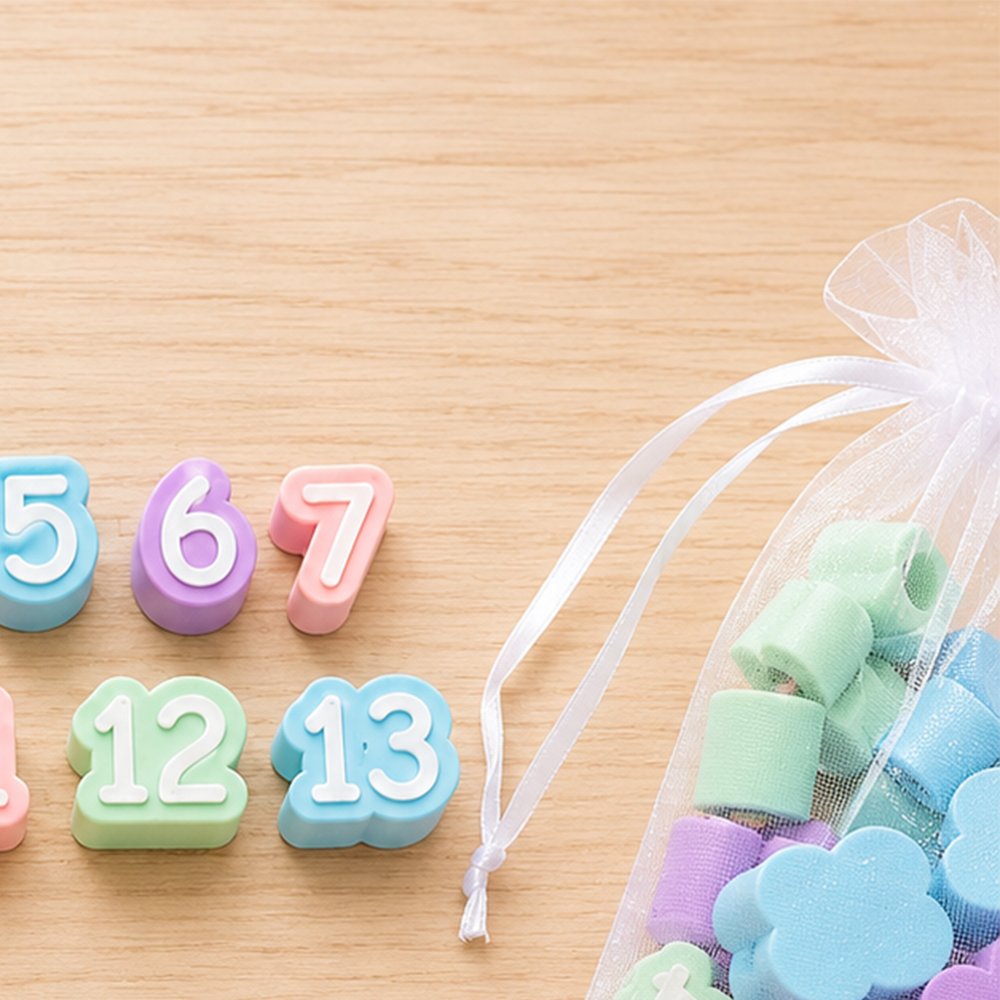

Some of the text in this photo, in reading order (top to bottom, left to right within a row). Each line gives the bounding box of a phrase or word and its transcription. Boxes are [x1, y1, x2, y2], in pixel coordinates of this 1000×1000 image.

[4, 473, 78, 585] 5
[161, 475, 237, 587] 6
[301, 482, 375, 588] 7
[94, 694, 227, 804] 12
[304, 692, 440, 803] 13
